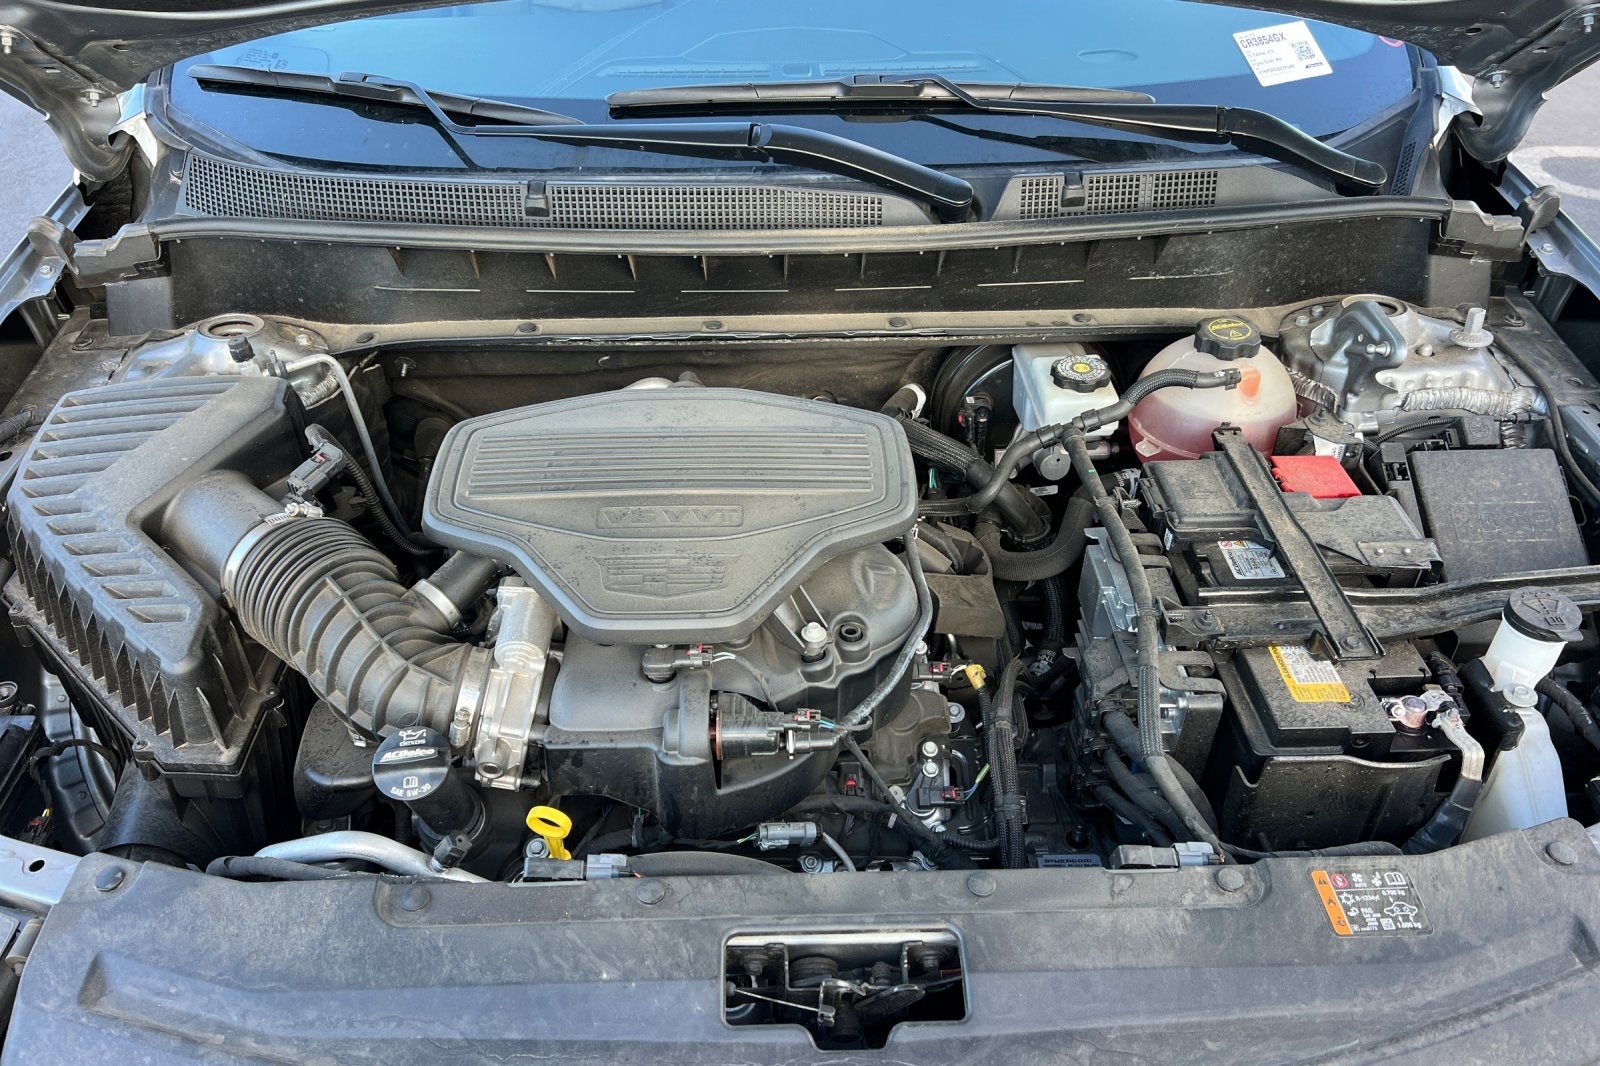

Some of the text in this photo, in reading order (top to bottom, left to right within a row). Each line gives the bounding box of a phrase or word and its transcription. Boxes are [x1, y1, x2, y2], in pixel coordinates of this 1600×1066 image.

[1240, 32, 1287, 49] CR3854GX
[400, 739, 426, 747] dexos
[380, 748, 435, 762] ACDelco
[390, 782, 431, 797] SAE 5W-30
